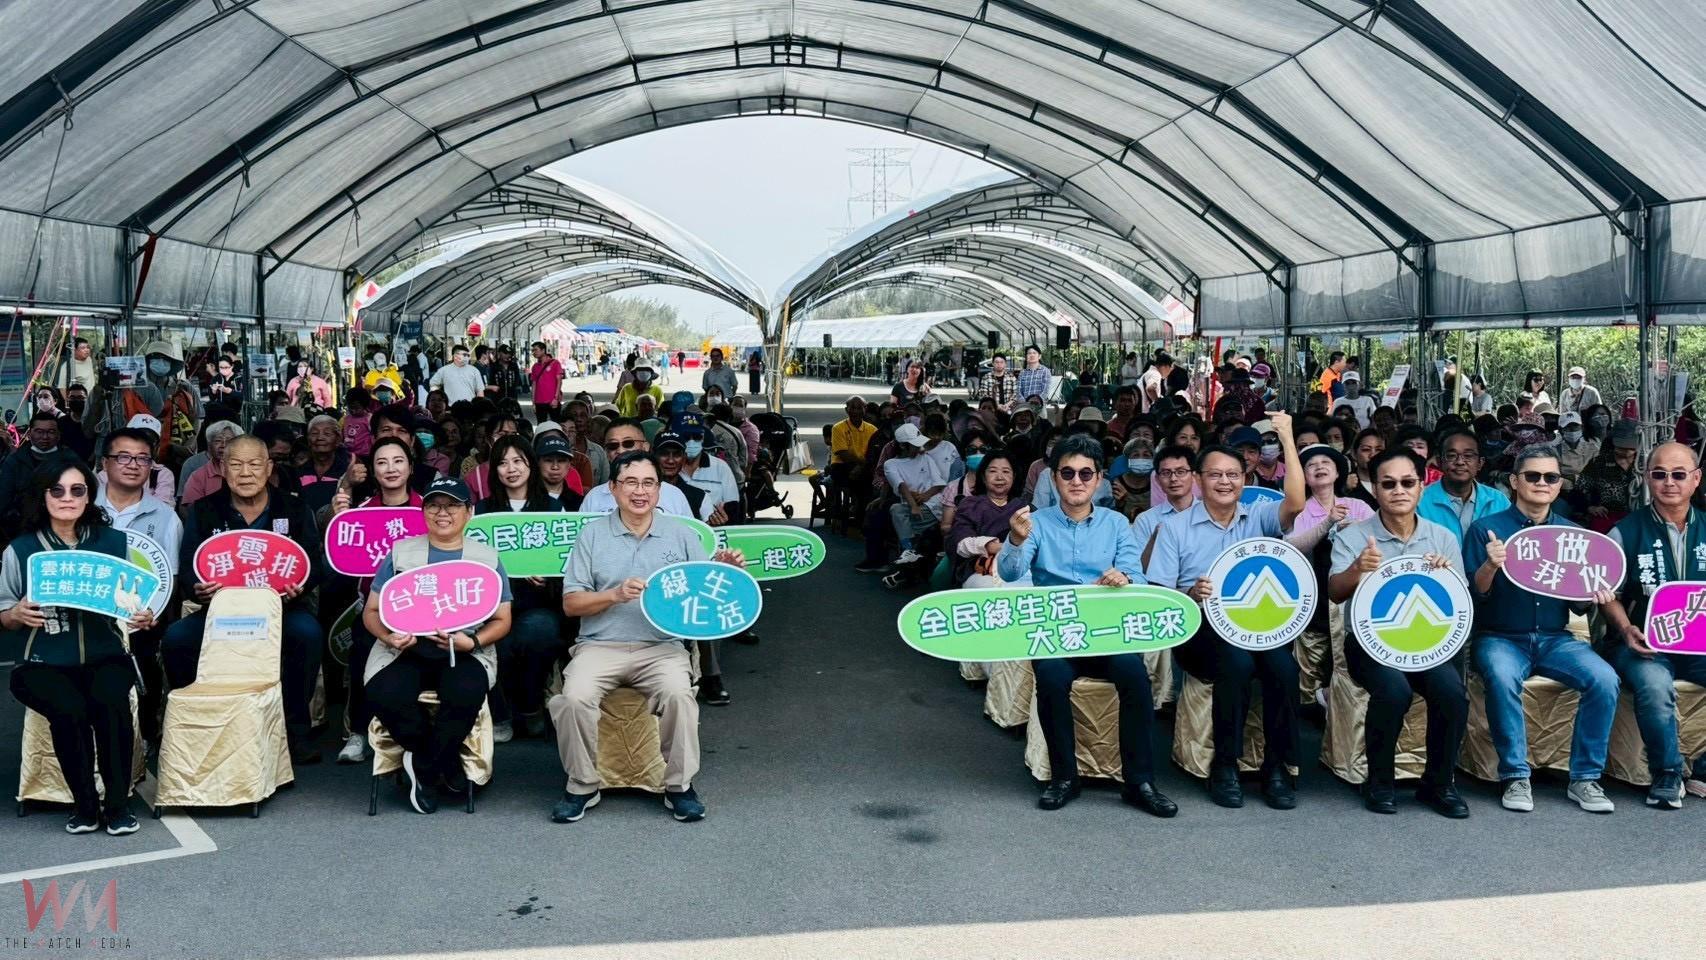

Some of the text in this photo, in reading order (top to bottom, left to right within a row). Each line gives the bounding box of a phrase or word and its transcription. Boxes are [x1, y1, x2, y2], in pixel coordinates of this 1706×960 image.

[465, 517, 588, 552] 全民綠生
[1234, 543, 1286, 559] 環境部
[39, 560, 113, 580] 雲林有夢
[39, 580, 112, 600] 生態共好
[388, 573, 485, 618] 台灣共好
[918, 588, 1080, 637] 全民綠生活
[1026, 608, 1187, 657] 大家一起來
[1209, 594, 1311, 644] Ministry of Environment
[1359, 610, 1467, 665] Ministry of Environment
